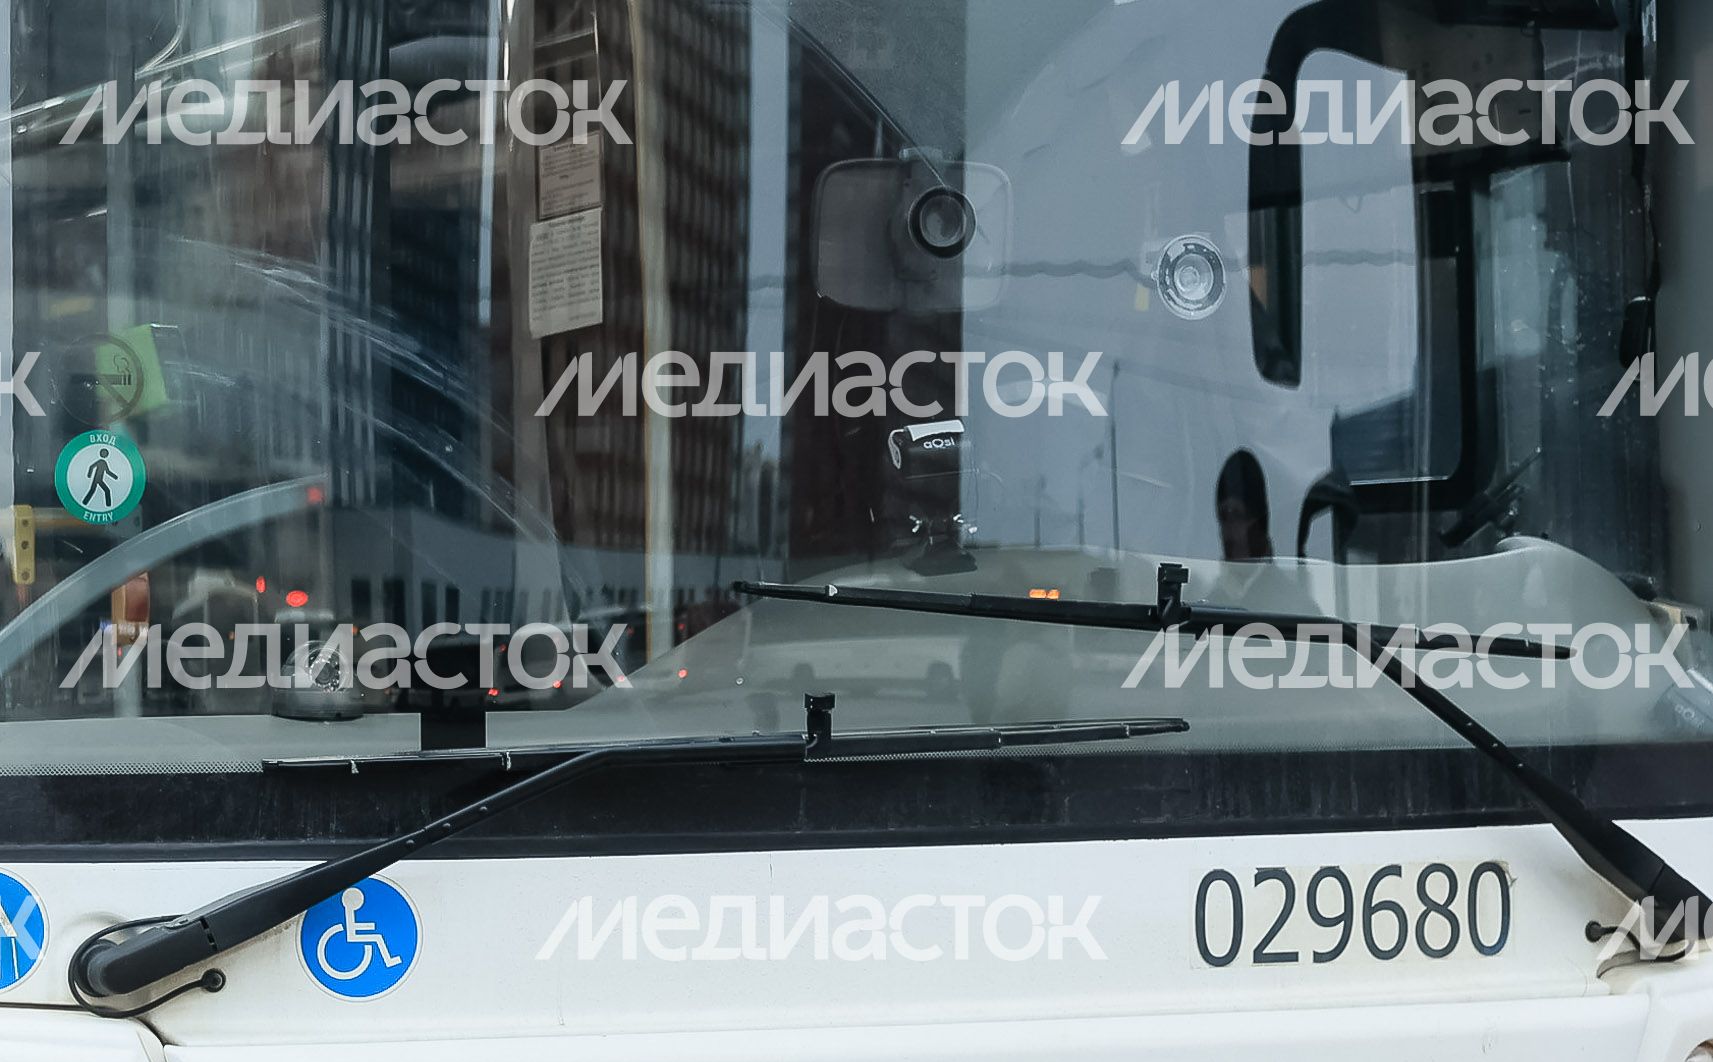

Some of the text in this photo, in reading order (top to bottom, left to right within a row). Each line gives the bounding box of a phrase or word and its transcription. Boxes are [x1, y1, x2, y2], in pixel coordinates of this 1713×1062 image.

[89, 433, 116, 446] ВХОД
[83, 511, 113, 522] ENTRY
[1195, 861, 1511, 968] 029680
